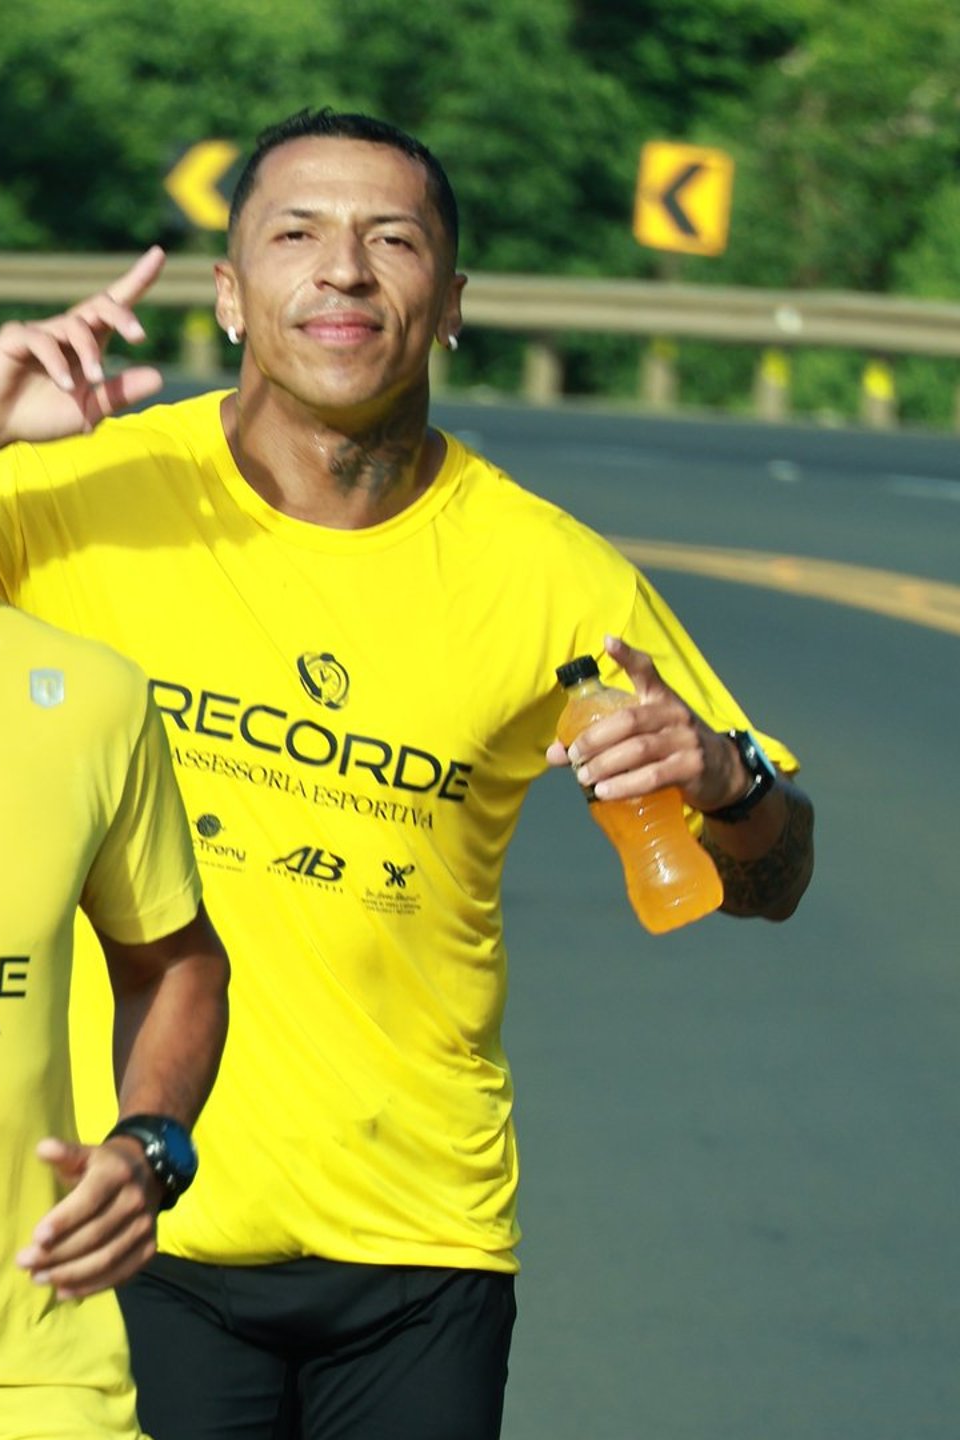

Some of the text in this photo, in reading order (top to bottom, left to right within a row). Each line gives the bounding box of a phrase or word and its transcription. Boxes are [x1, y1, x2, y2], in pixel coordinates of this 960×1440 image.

[147, 677, 473, 802] RECORDE
[171, 746, 435, 831] ASSESSORIA ESPORTIVA
[272, 846, 347, 882] AB
